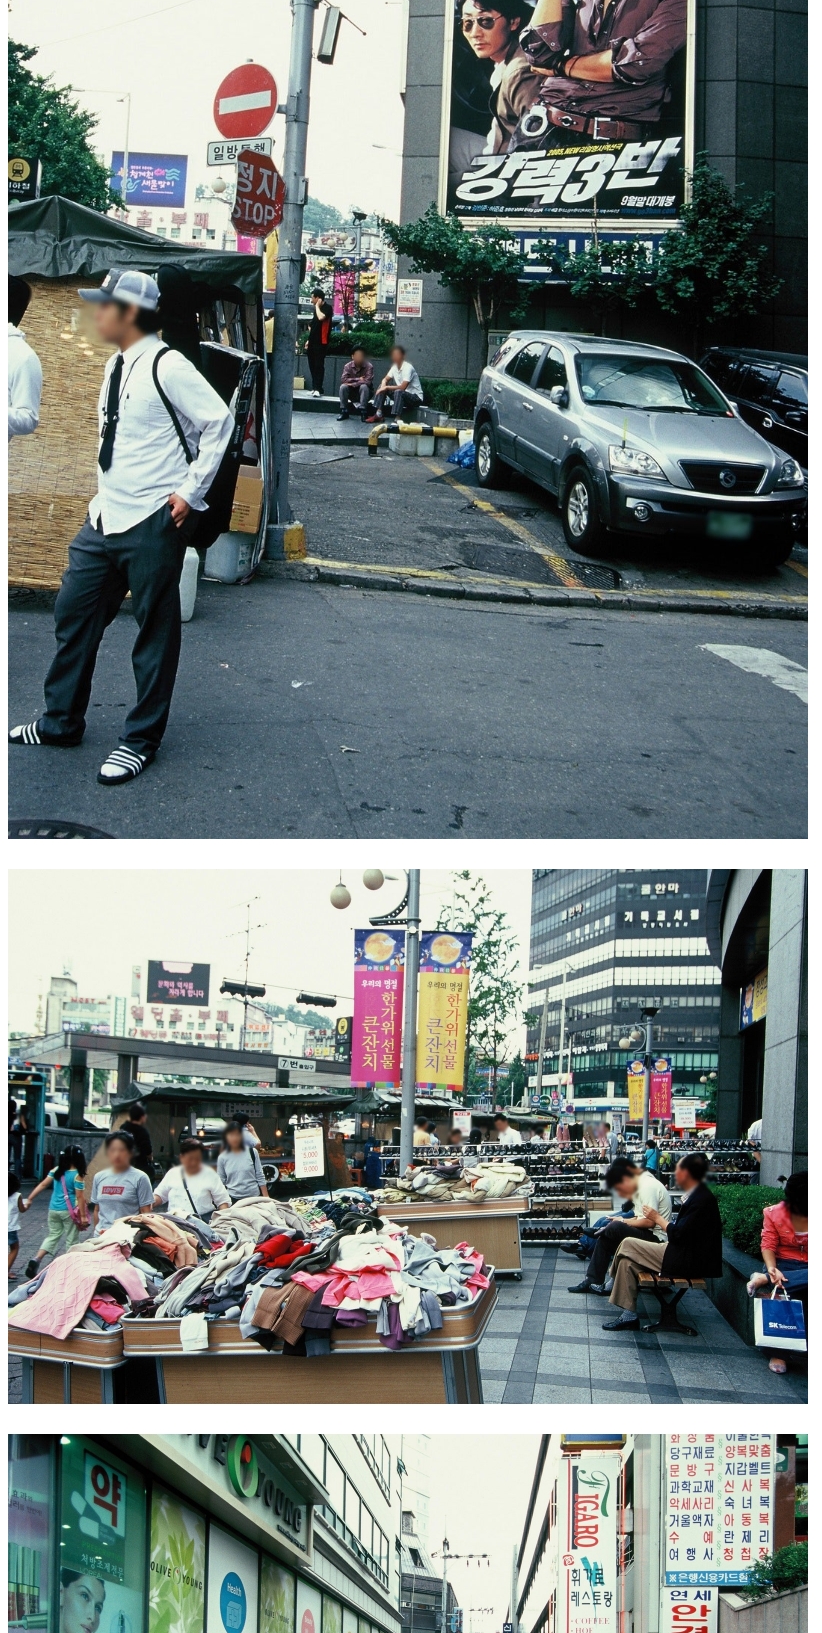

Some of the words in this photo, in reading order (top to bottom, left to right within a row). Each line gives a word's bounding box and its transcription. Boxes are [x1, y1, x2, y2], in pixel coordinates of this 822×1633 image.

[456, 137, 683, 204] 강력3반
[130, 168, 154, 180] 청계천
[142, 179, 175, 191] 새물맞이
[238, 161, 277, 200] 정지
[620, 196, 648, 207] 9월말
[648, 195, 676, 207] 대개봉
[234, 197, 276, 226] STOP
[360, 979, 382, 988] 우리의
[384, 979, 398, 990] 명절
[426, 981, 447, 990] 우리의
[450, 981, 463, 992] 명절
[380, 991, 398, 1036] 한가위
[446, 993, 462, 1037] 한가위
[380, 1039, 396, 1070] 선물
[443, 1039, 458, 1071] 선물
[290, 1059, 298, 1069] 번
[768, 1321, 779, 1329] SK
[670, 1447, 715, 1461] 당구재료
[725, 1445, 772, 1459] 양복맞춤
[670, 1463, 715, 1478] 문방구
[725, 1462, 772, 1476] 지갑벨트
[670, 1481, 715, 1494] 과학교재
[725, 1479, 771, 1493] 신사복
[91, 1464, 122, 1528] 약
[725, 1495, 771, 1510] 숙녀복
[670, 1497, 715, 1511] 악세사리
[670, 1513, 715, 1528] 거울액자
[724, 1513, 771, 1527] 아동복
[724, 1530, 770, 1544] 란제리
[669, 1547, 714, 1562] 여행사
[724, 1547, 770, 1561] 청첩장
[150, 1561, 172, 1578] OLIVE
[182, 1573, 203, 1591] YOUNG
[571, 1567, 604, 1586] 휘가로
[226, 1583, 243, 1598] Health
[670, 1590, 712, 1602] 연세
[570, 1591, 613, 1608] 레스토랑
[575, 1617, 610, 1625] COFFEE
